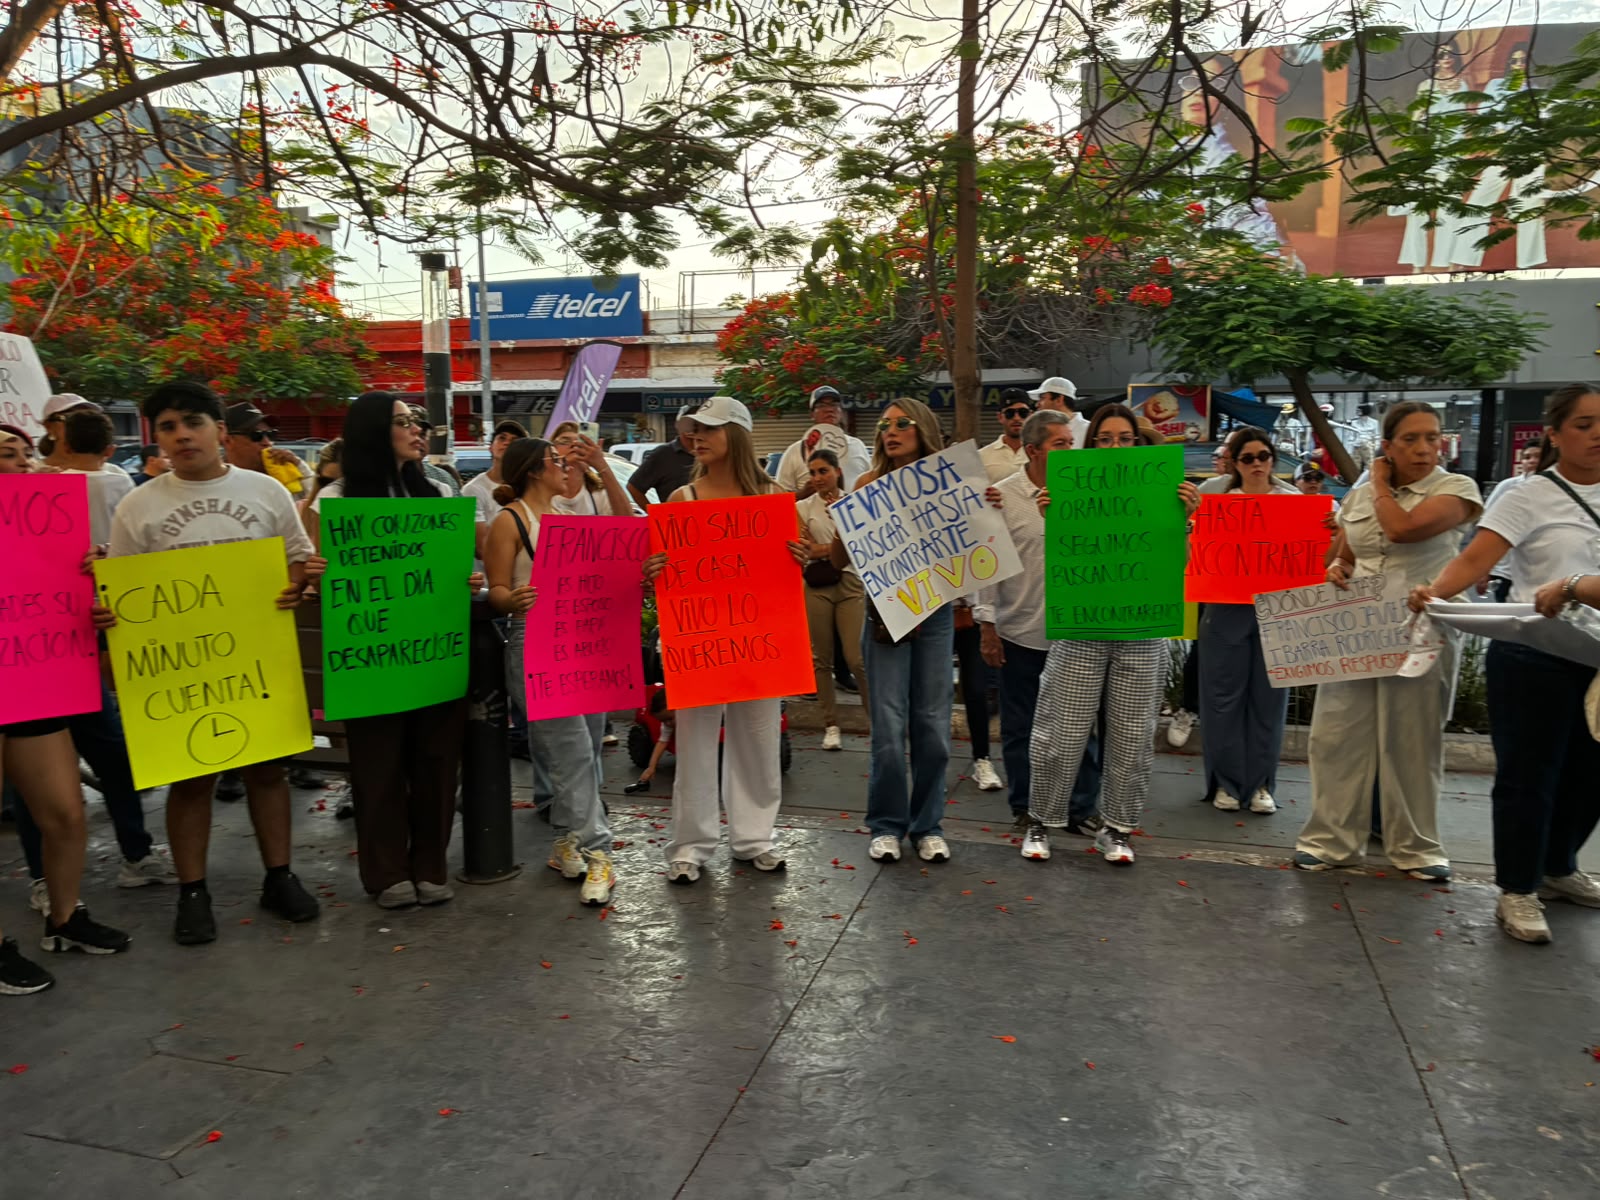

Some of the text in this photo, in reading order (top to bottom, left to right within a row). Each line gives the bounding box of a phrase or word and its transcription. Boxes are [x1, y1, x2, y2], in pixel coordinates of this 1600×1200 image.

[553, 291, 632, 318] telcel
[1057, 461, 1170, 492] SEGUIMOS
[161, 498, 259, 538] GYMSHARK
[328, 514, 364, 546] HAY
[831, 495, 865, 534] TE
[848, 485, 984, 569] BUSCAR HASTA
[1196, 497, 1266, 536] HASTA
[862, 520, 979, 598] ENCONTRARTE
[1059, 531, 1152, 557] SEGUIMOS
[1185, 540, 1329, 579] NCONTRARTE
[663, 553, 750, 590] DE CASA
[331, 578, 361, 608] EN
[369, 575, 394, 602] EL
[347, 608, 390, 636] QUE
[727, 593, 759, 626] LO
[1048, 605, 1065, 624] TE
[1262, 611, 1357, 645] FRANCISCO
[327, 632, 464, 672] DESAPARECISTE
[554, 644, 568, 662] ES
[665, 633, 781, 674] QUEREMOS
[1269, 640, 1330, 667] IBARRA
[144, 660, 270, 721] CUENTA!
